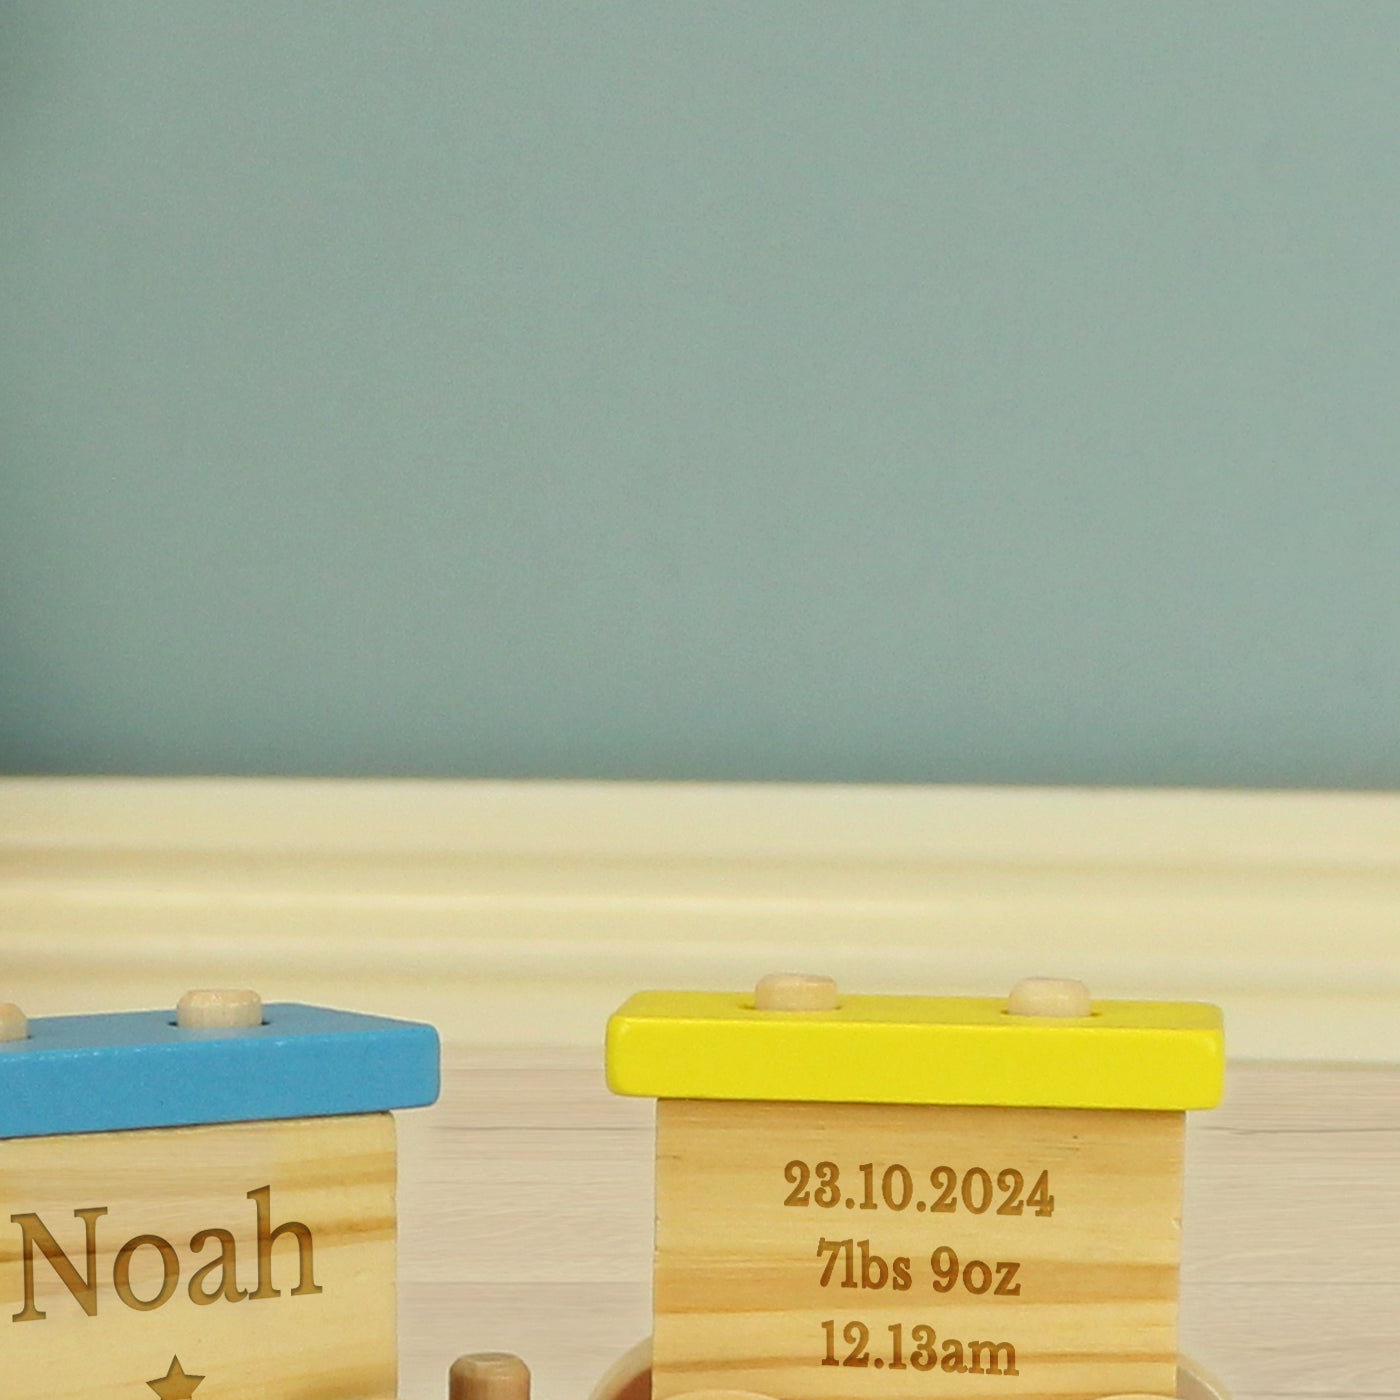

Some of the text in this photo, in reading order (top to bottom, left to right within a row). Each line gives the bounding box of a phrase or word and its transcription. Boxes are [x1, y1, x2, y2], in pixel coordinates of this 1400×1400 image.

[783, 1160, 1055, 1217] 23.10.2024
[10, 1184, 323, 1323] Noah
[816, 1237, 1021, 1296] 7lbs 9oz
[821, 1319, 1020, 1376] 12.13am
